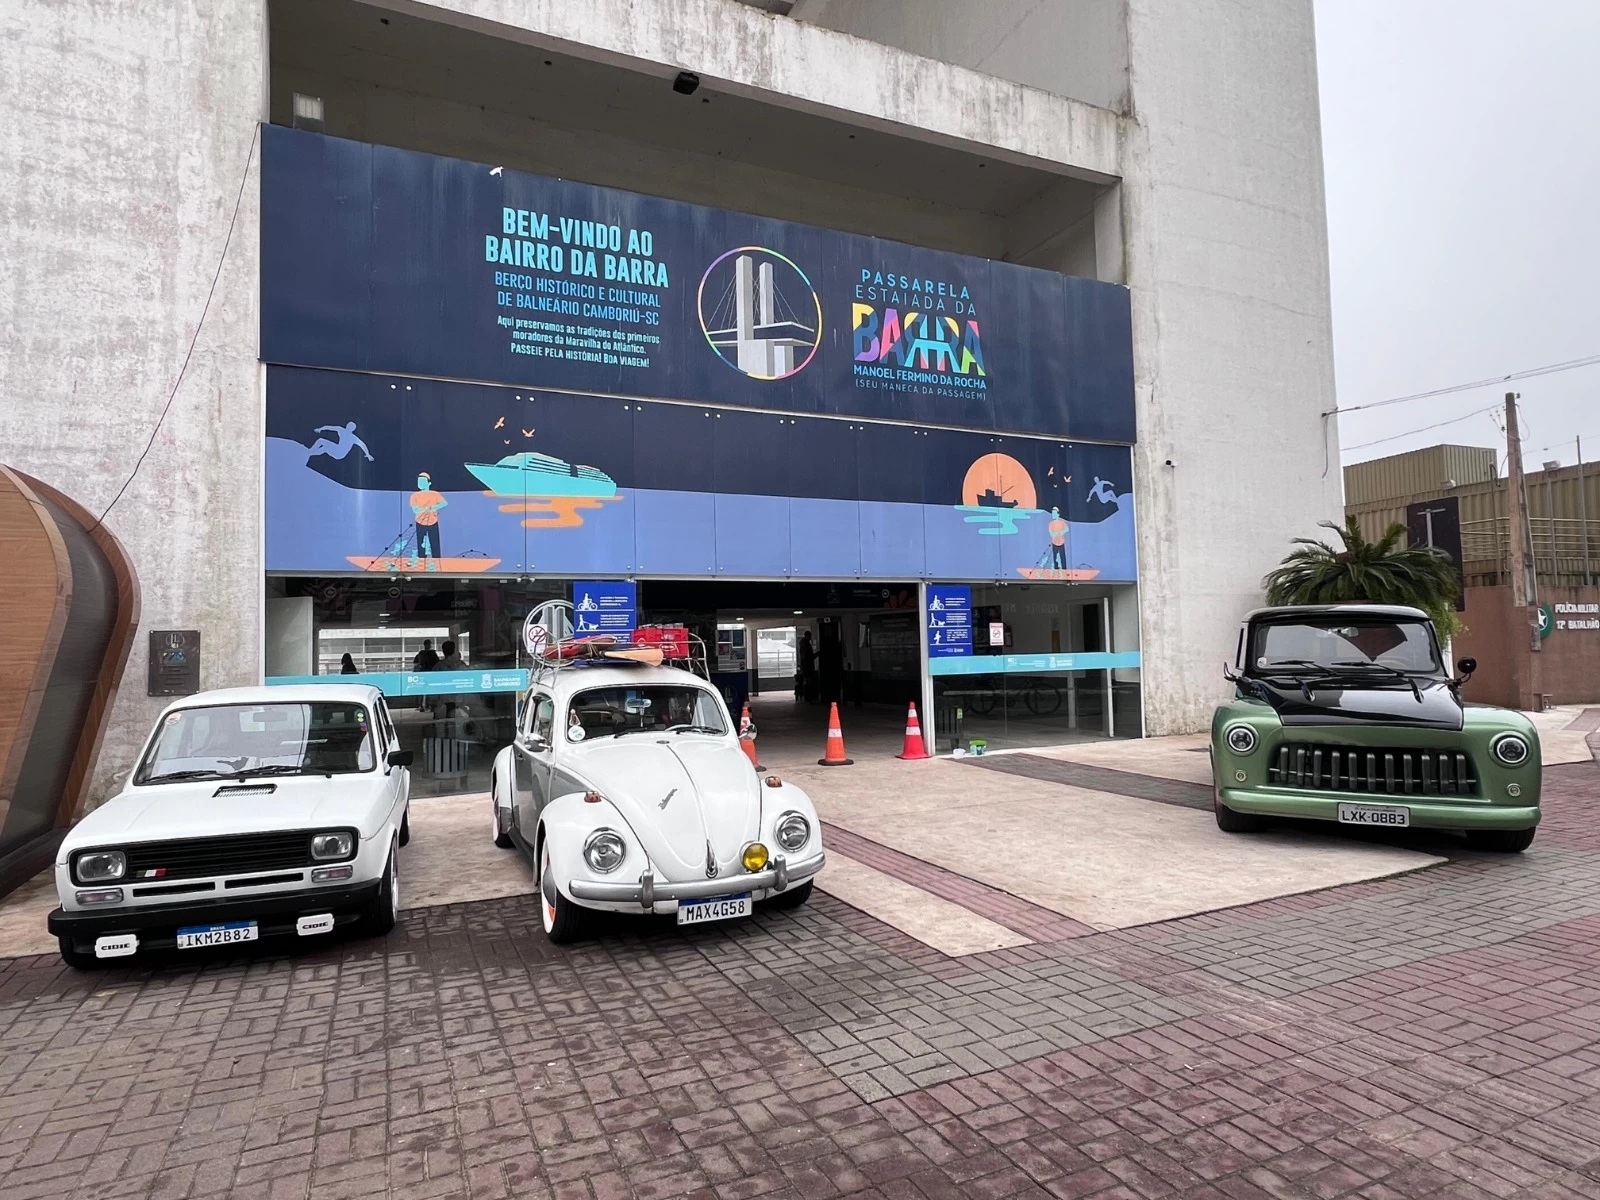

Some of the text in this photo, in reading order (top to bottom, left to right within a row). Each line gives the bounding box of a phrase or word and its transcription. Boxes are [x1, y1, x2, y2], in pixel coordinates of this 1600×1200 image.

[503, 207, 653, 257] BEM-VINDO AO
[485, 235, 669, 288] BAIRRO DA BARRA
[495, 271, 661, 308] BERÇO HISTÓRICO E CULTURAL
[861, 268, 970, 300] PASSARELA
[497, 291, 659, 326] DE BALNEÁRIO CAMBORIÚ-SC
[855, 284, 977, 316] ESTAIADA DA
[497, 315, 660, 345] Aqui preservamos as tradições dos primeiros
[512, 330, 647, 354] moradores da Maravilha do Atlântico.
[852, 302, 986, 377] BARRA
[511, 342, 650, 368] PASSEIE PELA HISTÓRIA! BOA VIAGEM!
[854, 364, 987, 390] MANOEL FERMINO DA ROCHA
[881, 381, 919, 394] MANECA
[922, 385, 934, 396] DA
[937, 387, 987, 401] PASSAGEM)
[1555, 602, 1599, 613] POLÍCIA MILITAR
[1568, 618, 1600, 629] BATALHÃO
[1341, 810, 1406, 825] LXK-0883
[686, 900, 746, 922] MAX4G58
[186, 928, 251, 947] IKM2B82
